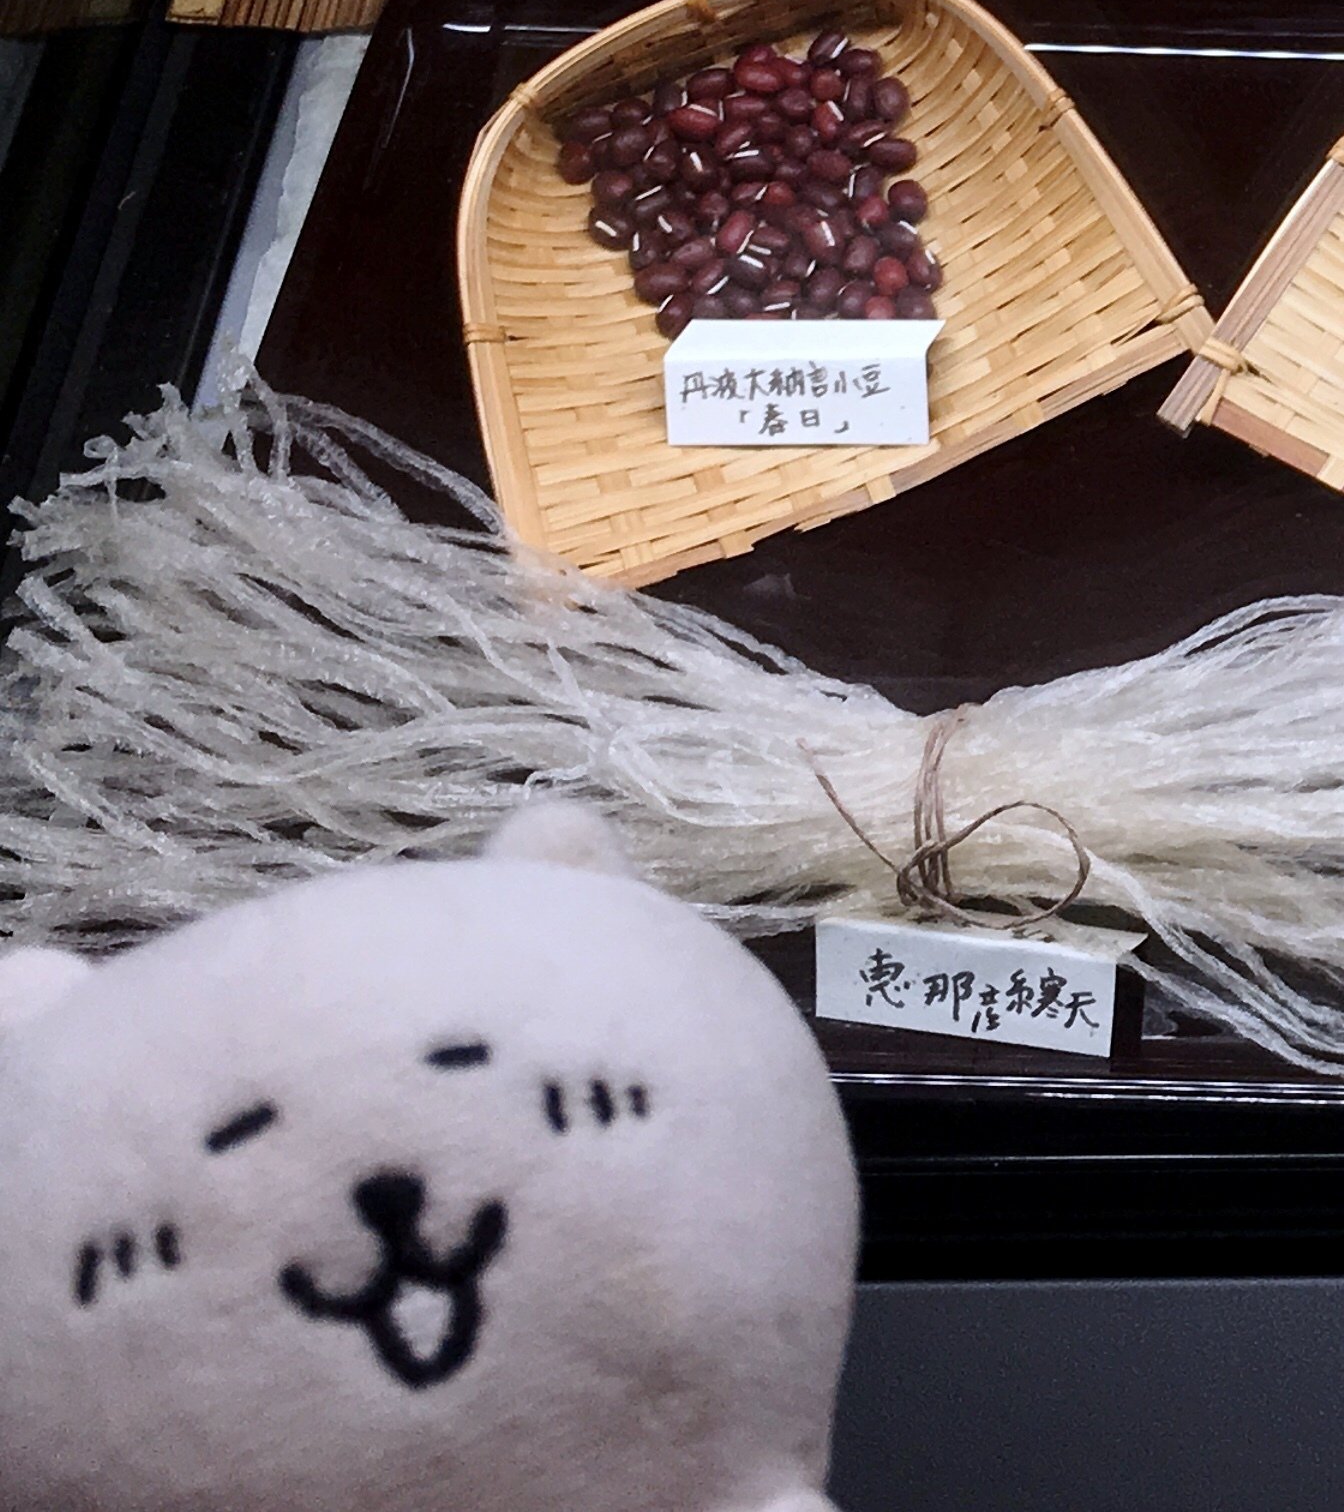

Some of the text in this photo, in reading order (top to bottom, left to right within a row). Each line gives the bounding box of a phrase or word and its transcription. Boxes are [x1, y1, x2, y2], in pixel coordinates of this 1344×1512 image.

[679, 361, 891, 402] 丹波大納言小豆
[740, 403, 850, 436] 「春日」
